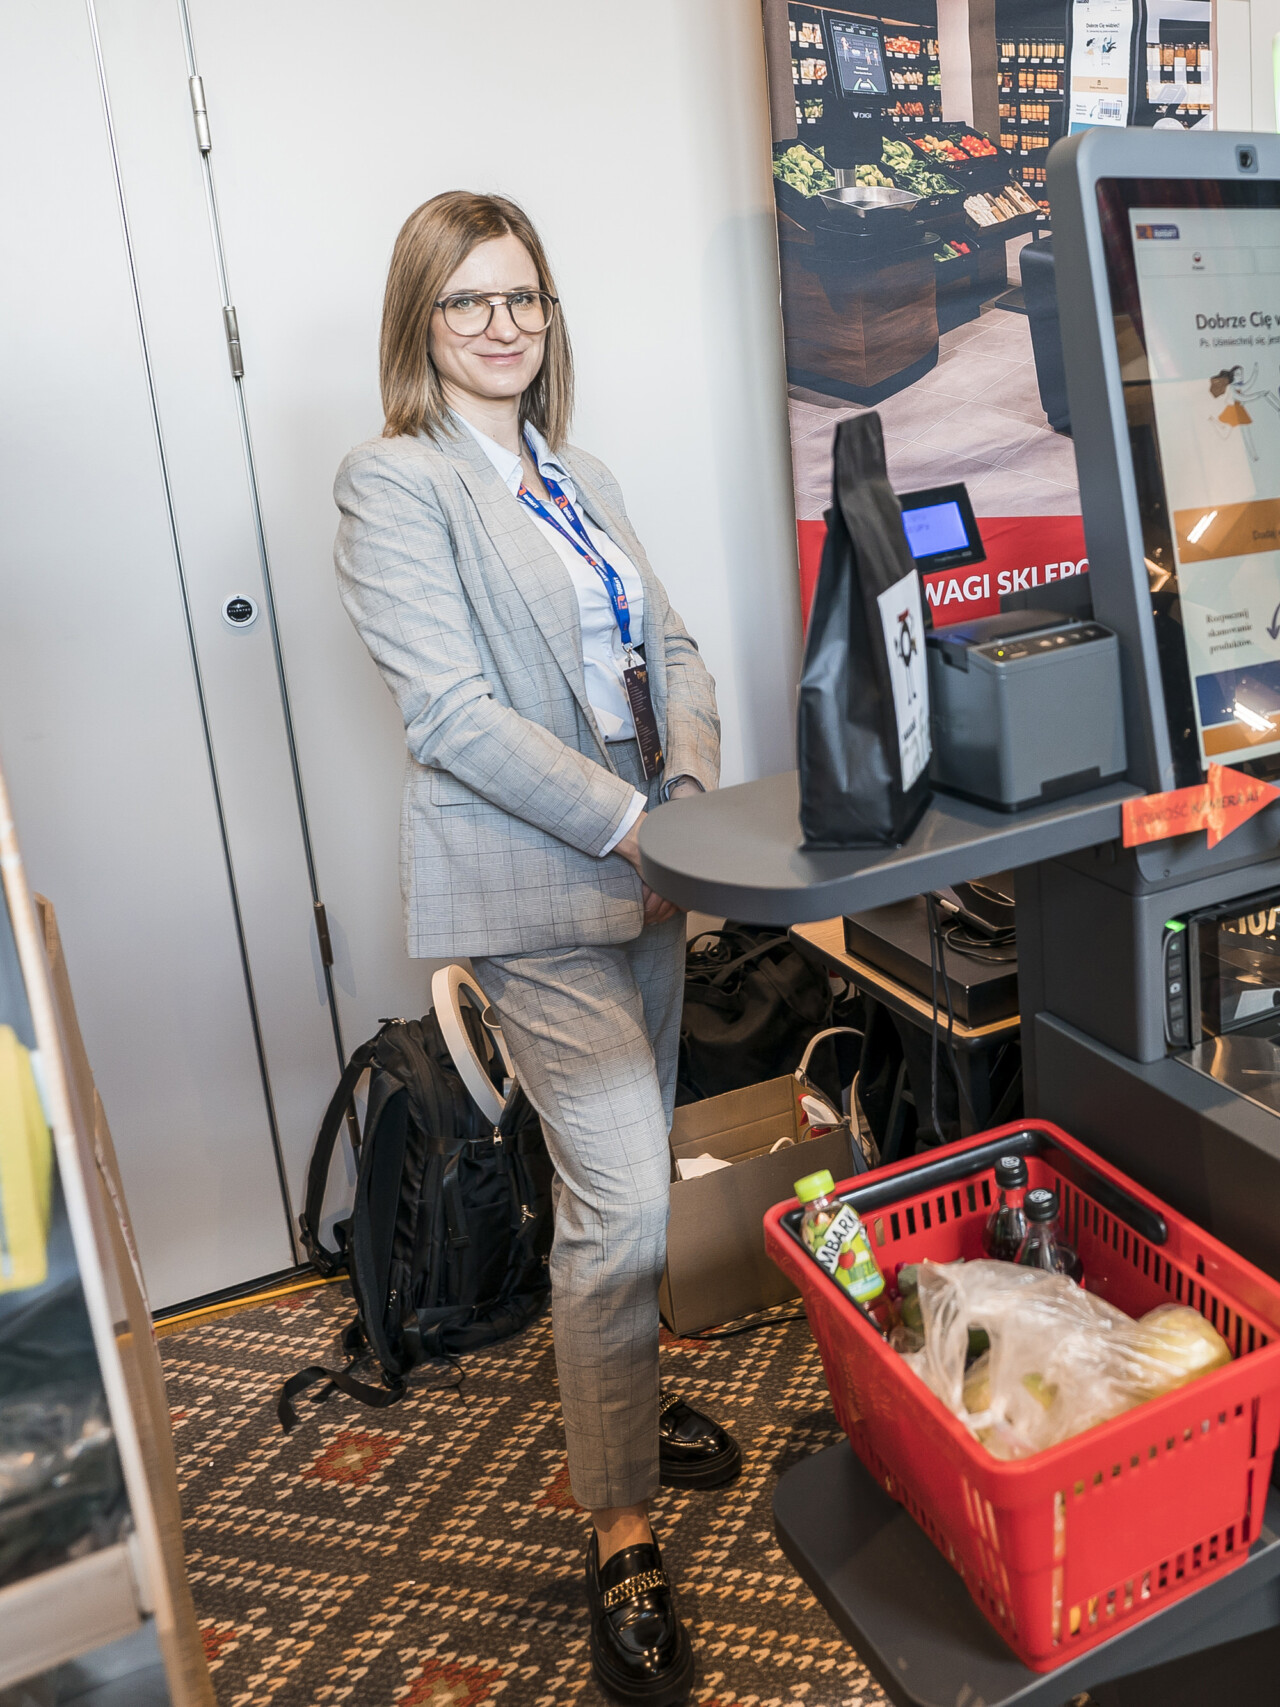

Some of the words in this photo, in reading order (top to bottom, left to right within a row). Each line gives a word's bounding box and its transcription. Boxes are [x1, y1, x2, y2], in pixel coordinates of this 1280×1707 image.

[1195, 312, 1247, 330] Dobrze
[1249, 311, 1272, 330] Cię
[925, 573, 991, 607] WAGI
